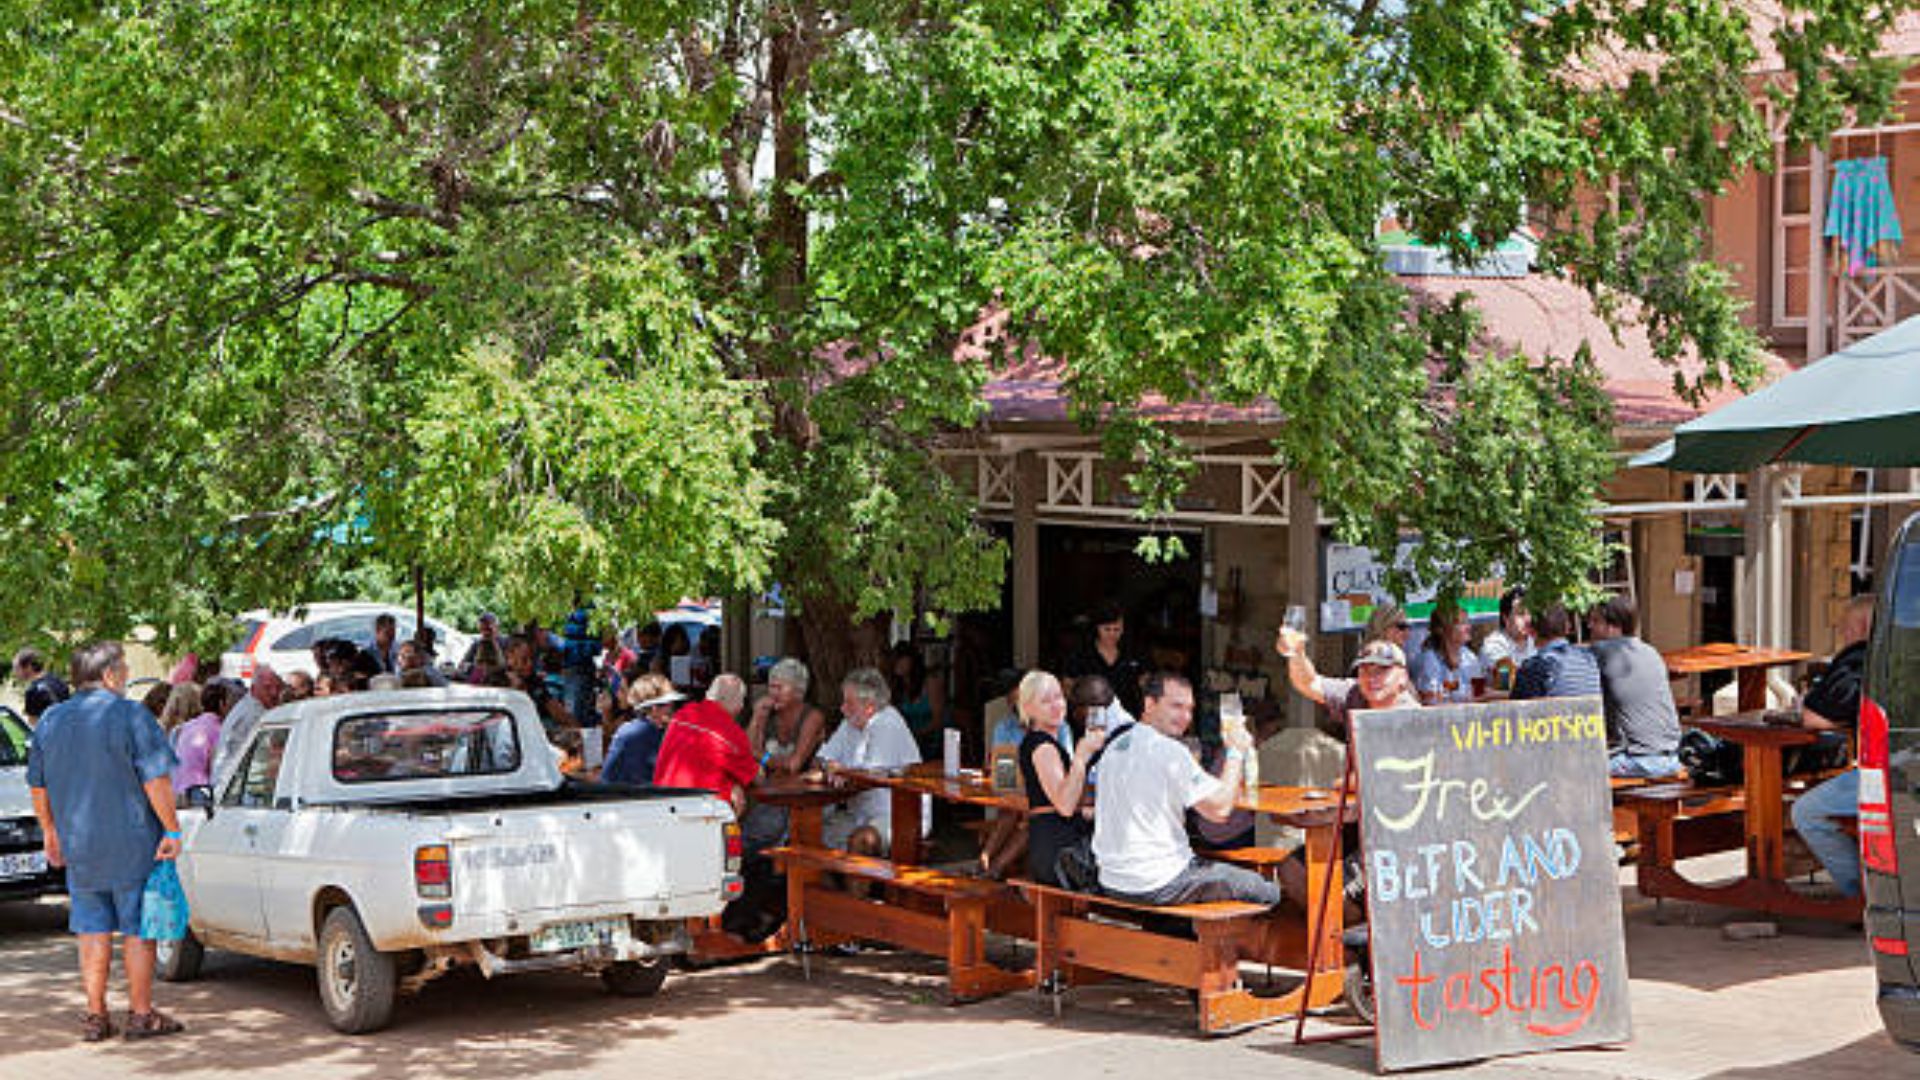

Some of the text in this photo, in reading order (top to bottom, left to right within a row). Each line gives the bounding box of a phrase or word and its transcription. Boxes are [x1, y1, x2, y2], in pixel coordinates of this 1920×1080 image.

[1452, 718, 1512, 751] WI-FI
[1374, 750, 1548, 831] Free
[1495, 828, 1582, 886] AND
[1396, 944, 1601, 1037] tasting
